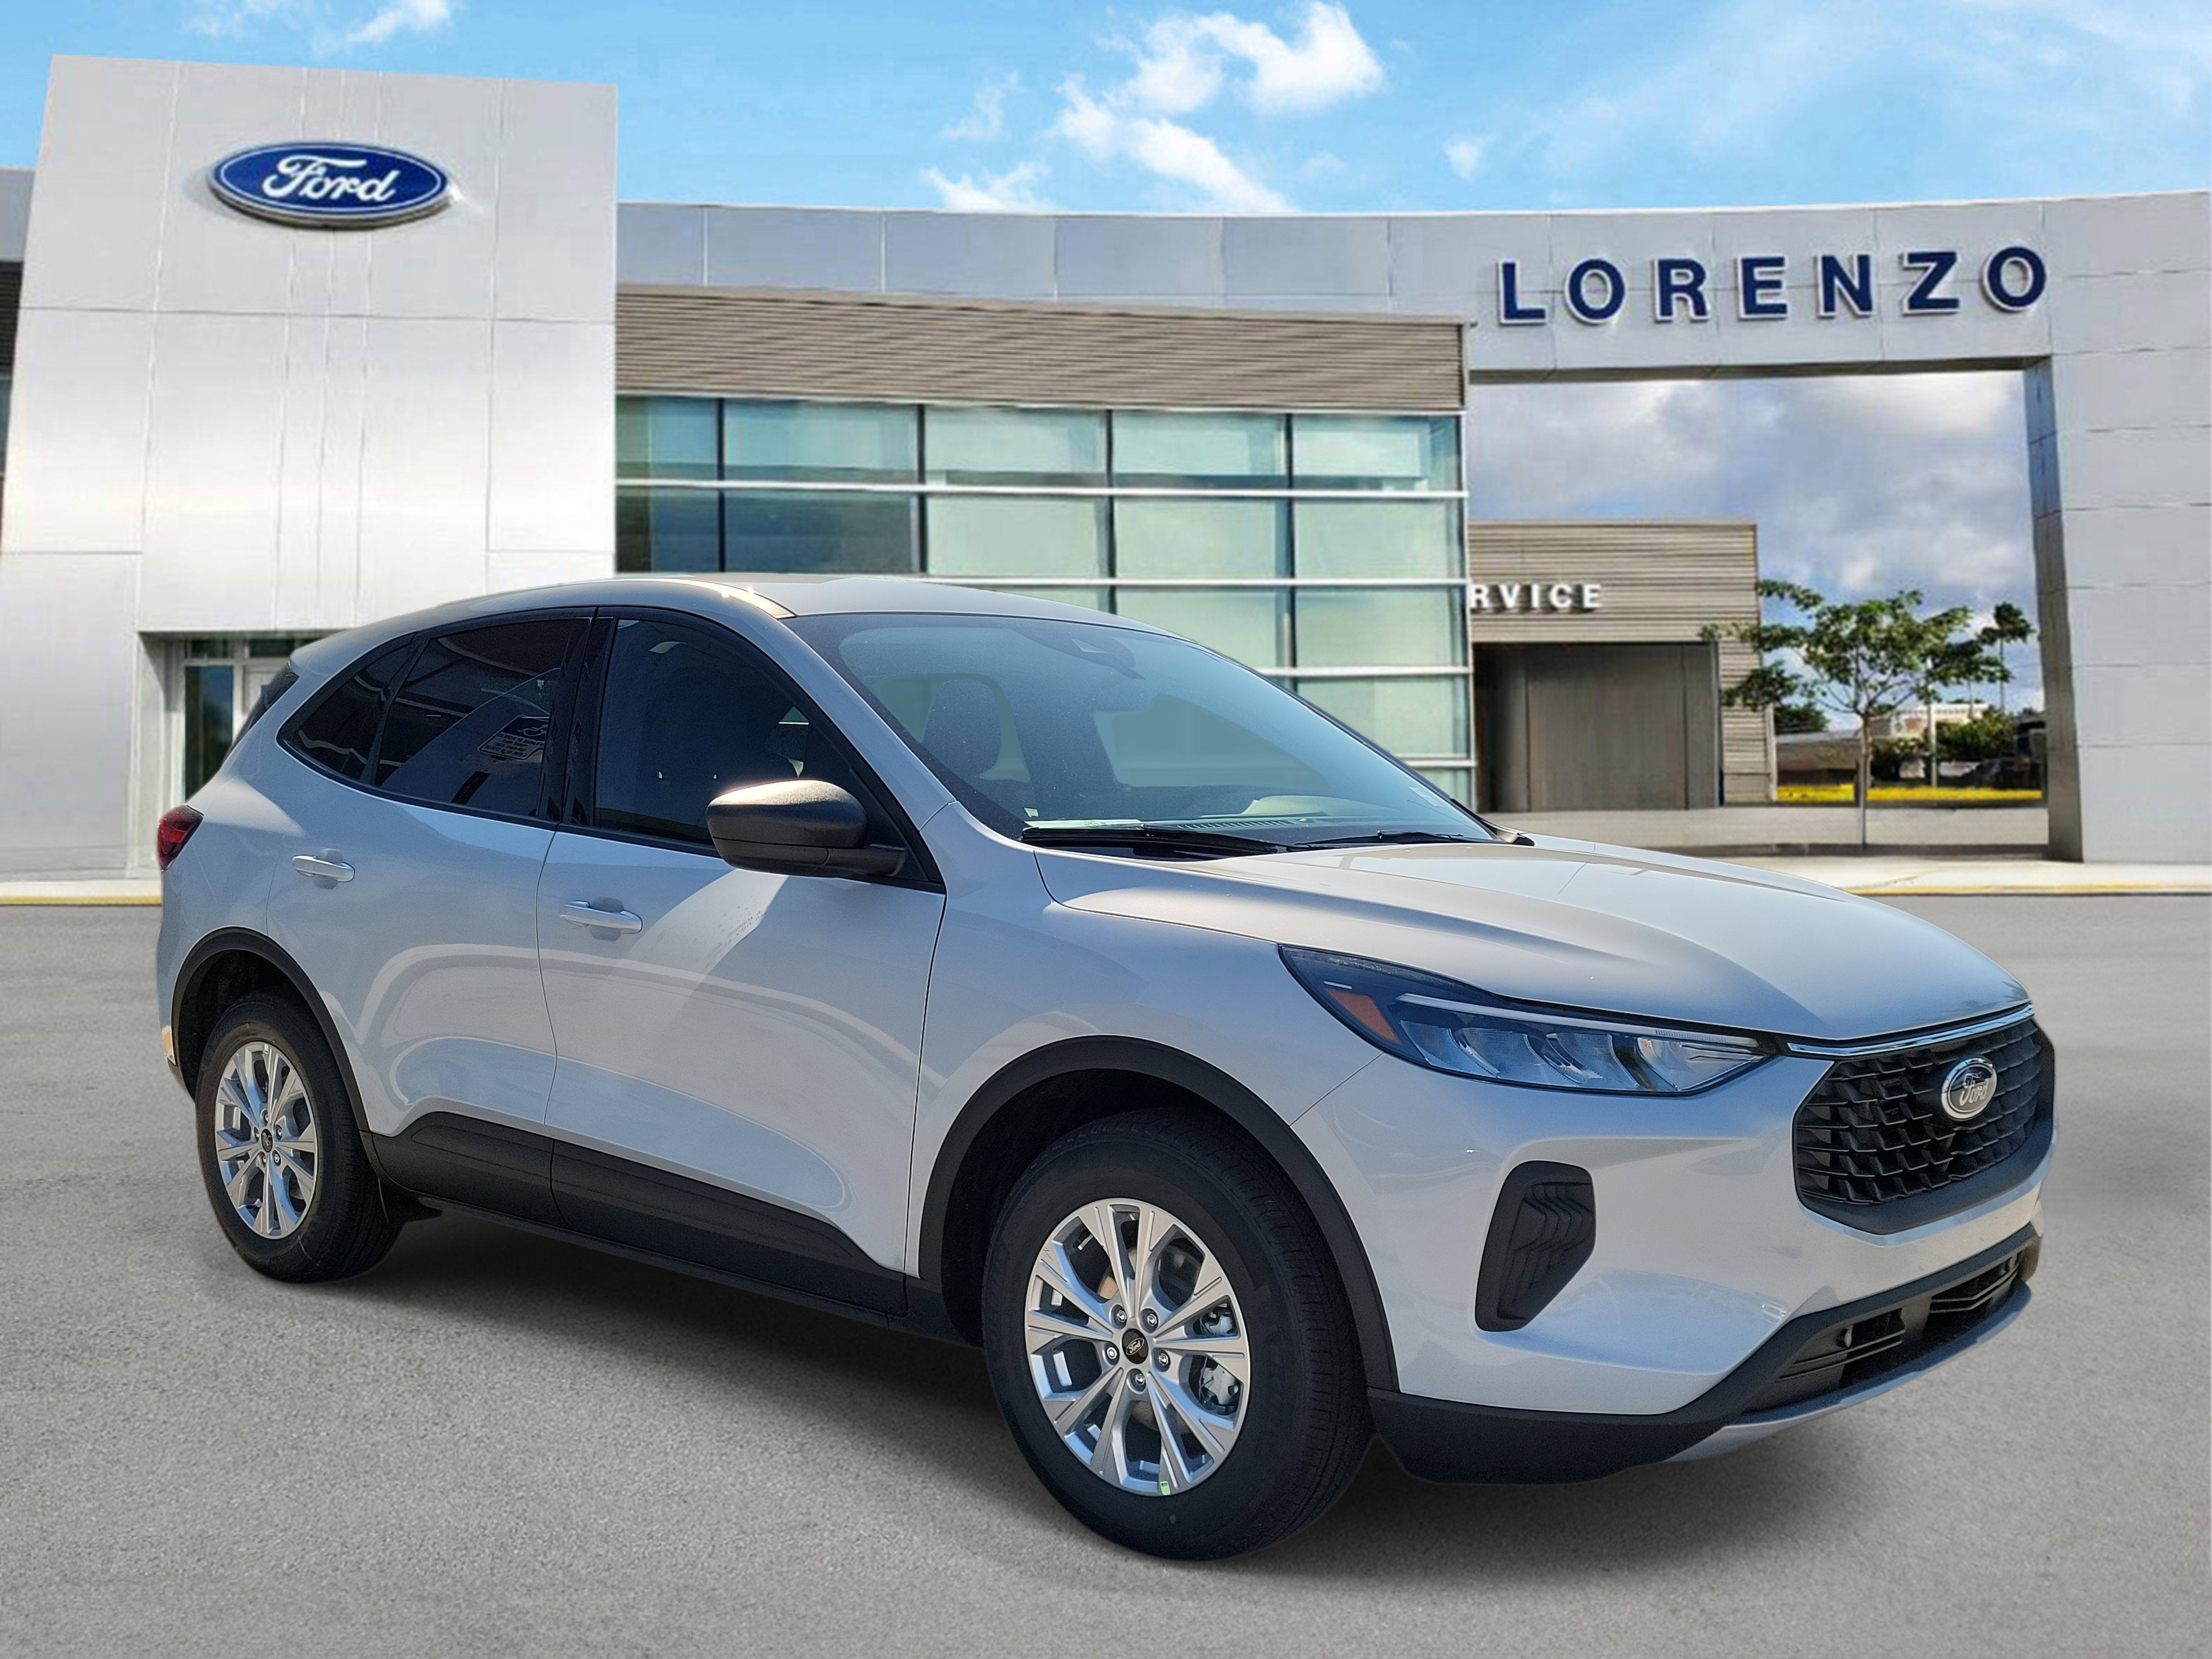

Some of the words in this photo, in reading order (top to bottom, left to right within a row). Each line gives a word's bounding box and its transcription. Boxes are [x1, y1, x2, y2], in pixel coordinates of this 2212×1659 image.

[262, 154, 400, 201] Ford
[1496, 245, 2047, 326] LORENZO
[1960, 1071, 1989, 1106] Ford
